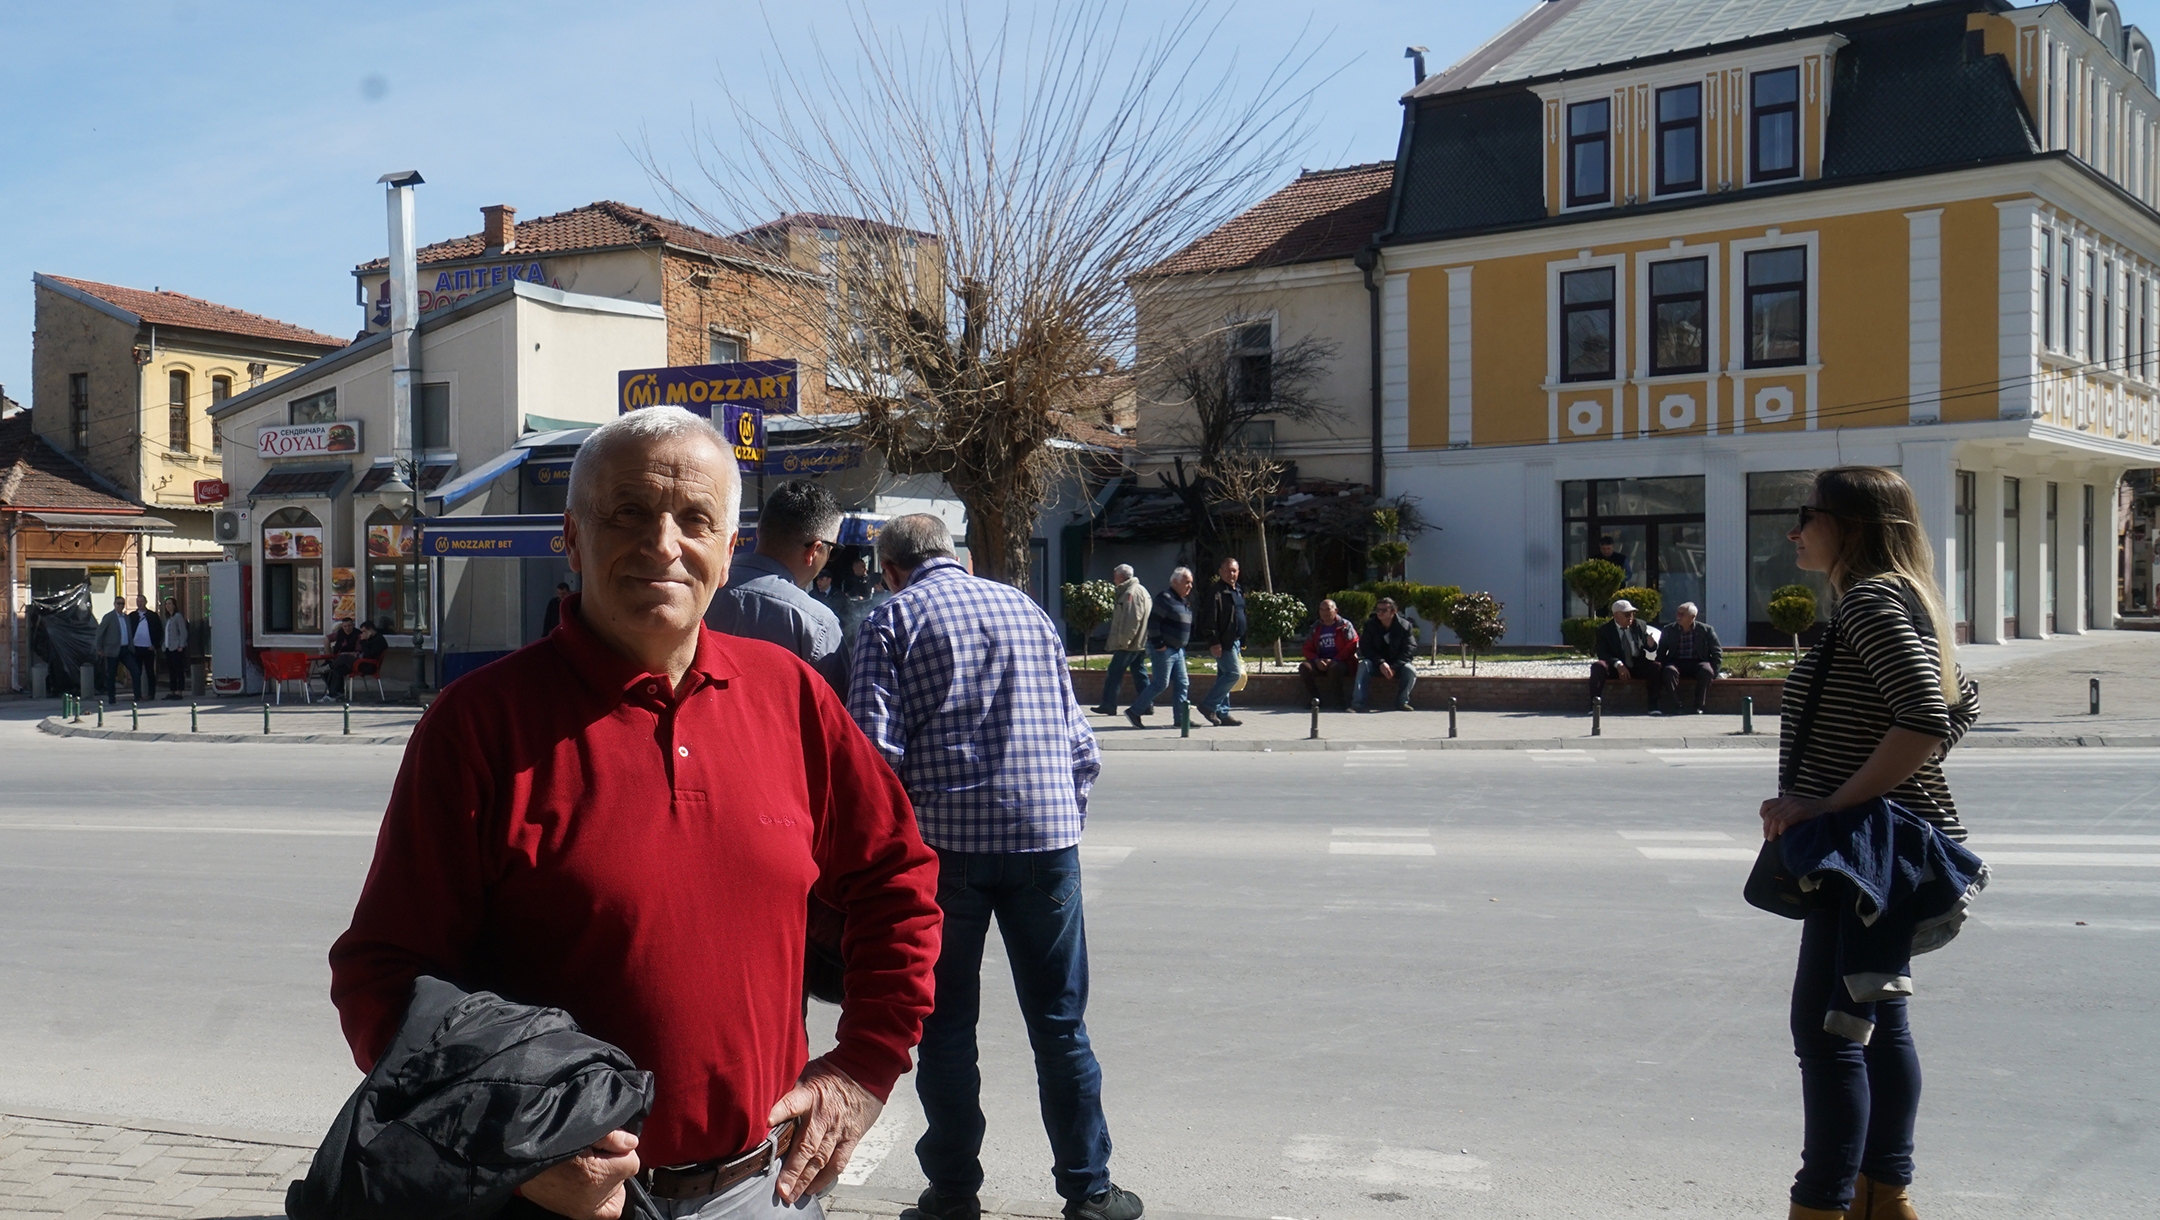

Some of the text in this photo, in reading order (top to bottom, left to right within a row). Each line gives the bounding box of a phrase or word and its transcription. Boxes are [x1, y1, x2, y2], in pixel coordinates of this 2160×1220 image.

[435, 262, 546, 292] АПТЕКА
[665, 375, 792, 403] MOZZART
[280, 427, 326, 436] СЕНДВИЧАРА
[260, 431, 328, 455] ROYAL
[732, 445, 765, 461] OZZART
[451, 540, 496, 549] MOZZART
[498, 540, 513, 548] BET
